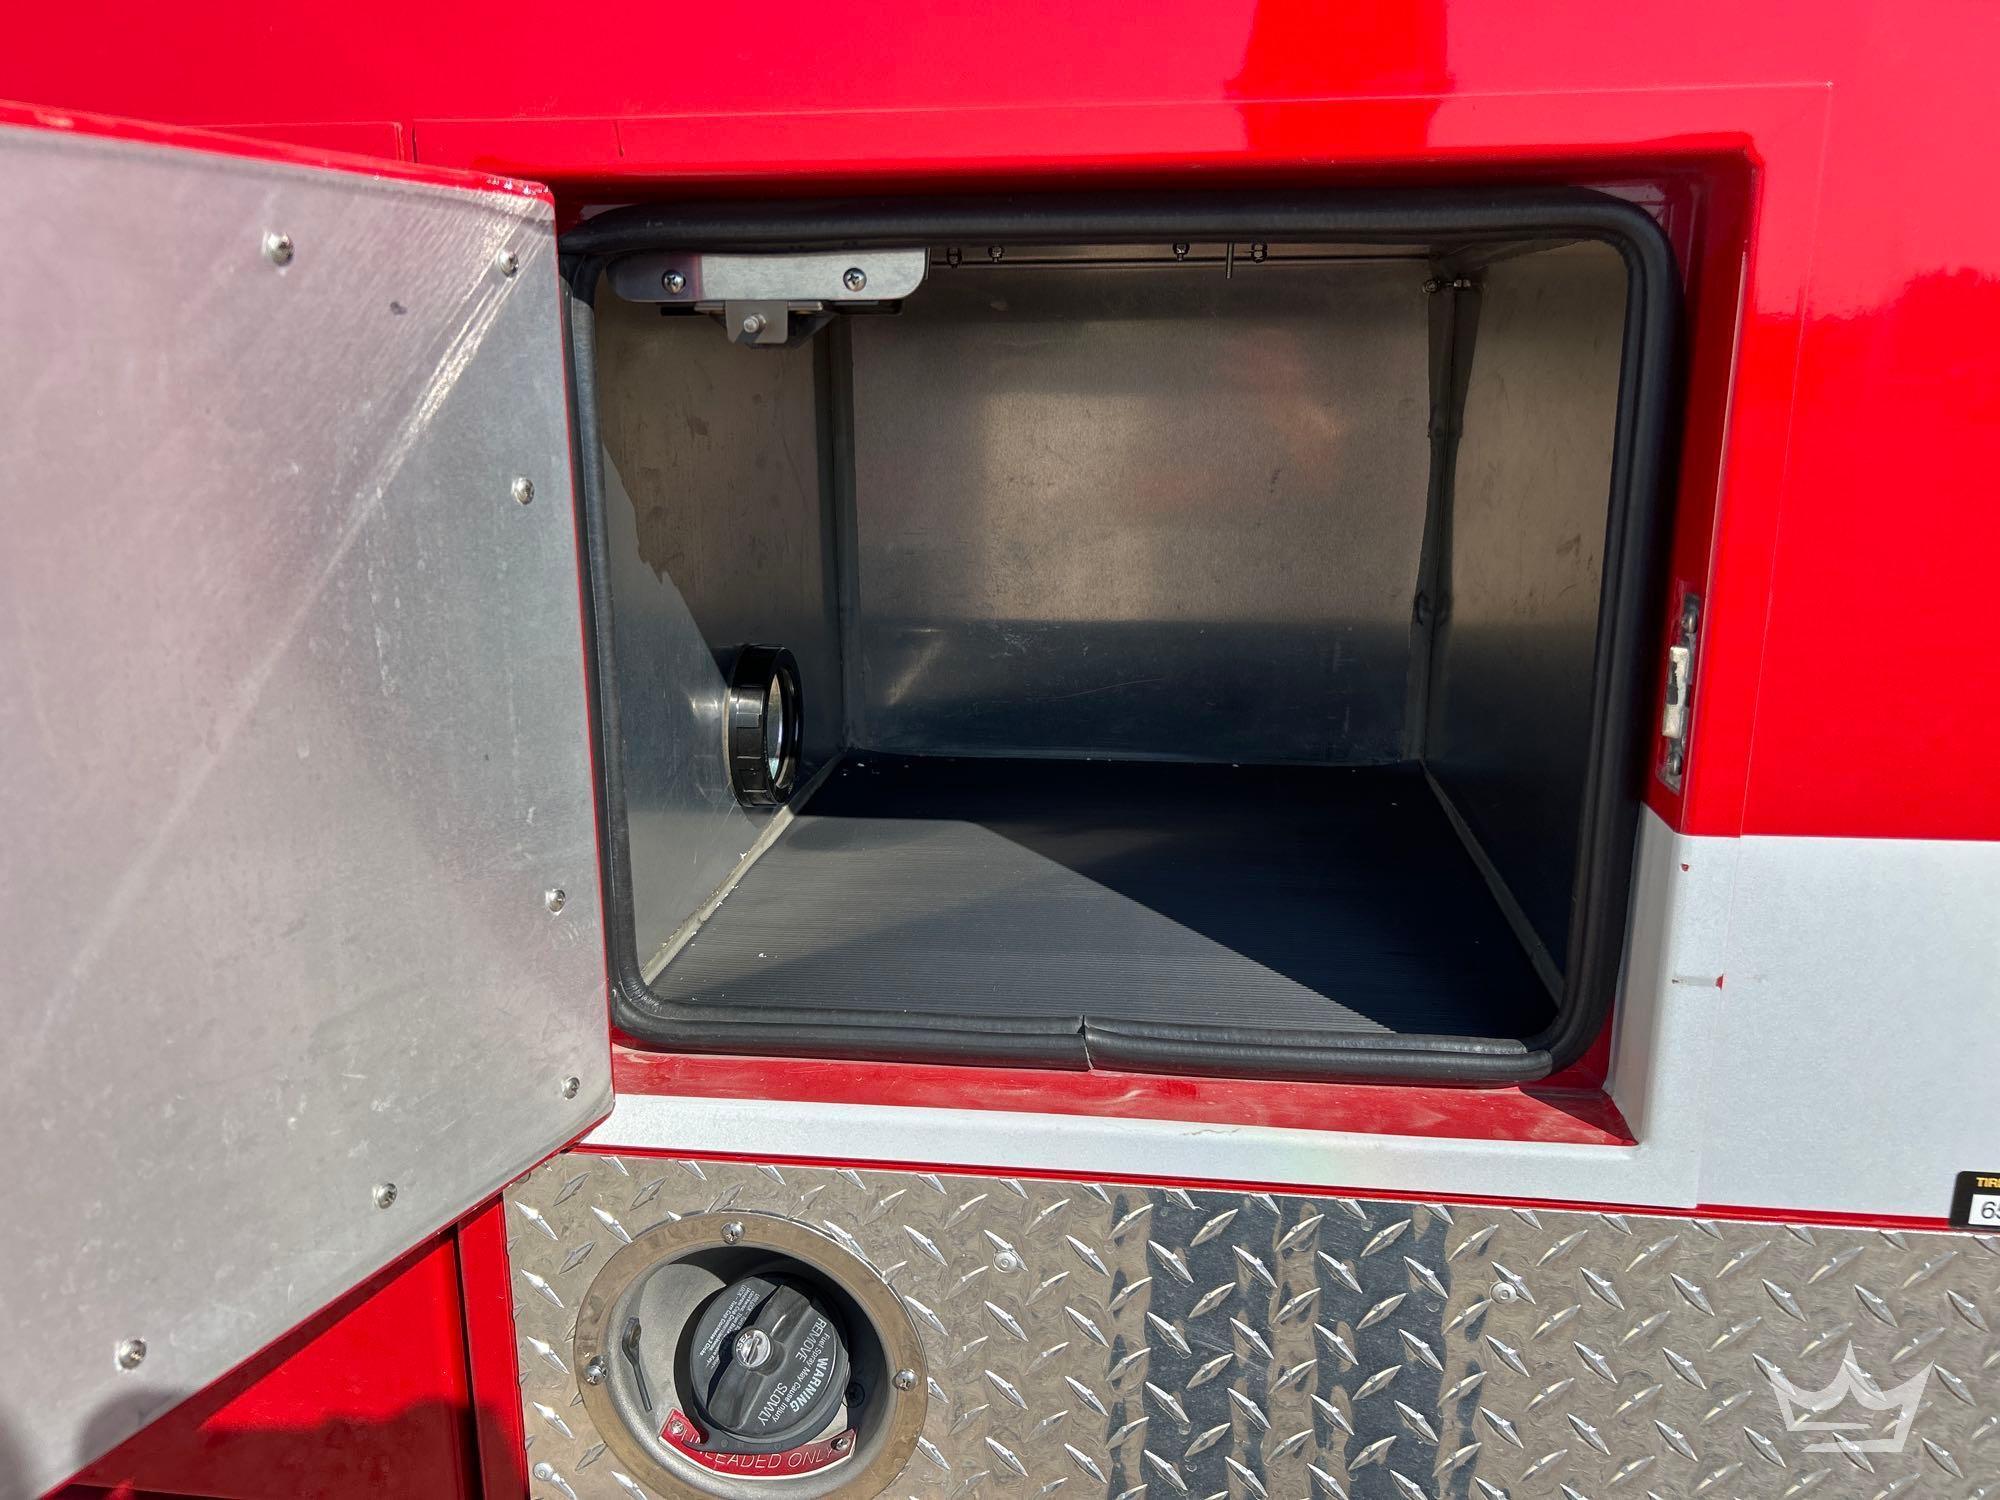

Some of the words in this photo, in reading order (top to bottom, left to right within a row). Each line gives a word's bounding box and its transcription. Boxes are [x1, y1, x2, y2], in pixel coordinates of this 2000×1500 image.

[796, 1318, 827, 1362] REMOVE
[817, 1332, 830, 1348] Fuel
[804, 1346, 822, 1367] Spray
[795, 1365, 810, 1382] May
[783, 1380, 801, 1403] Cause
[790, 1358, 829, 1412] WARNING
[758, 1383, 787, 1426] SLOWLY
[770, 1401, 788, 1423] Injury
[788, 1446, 832, 1468] ONLY
